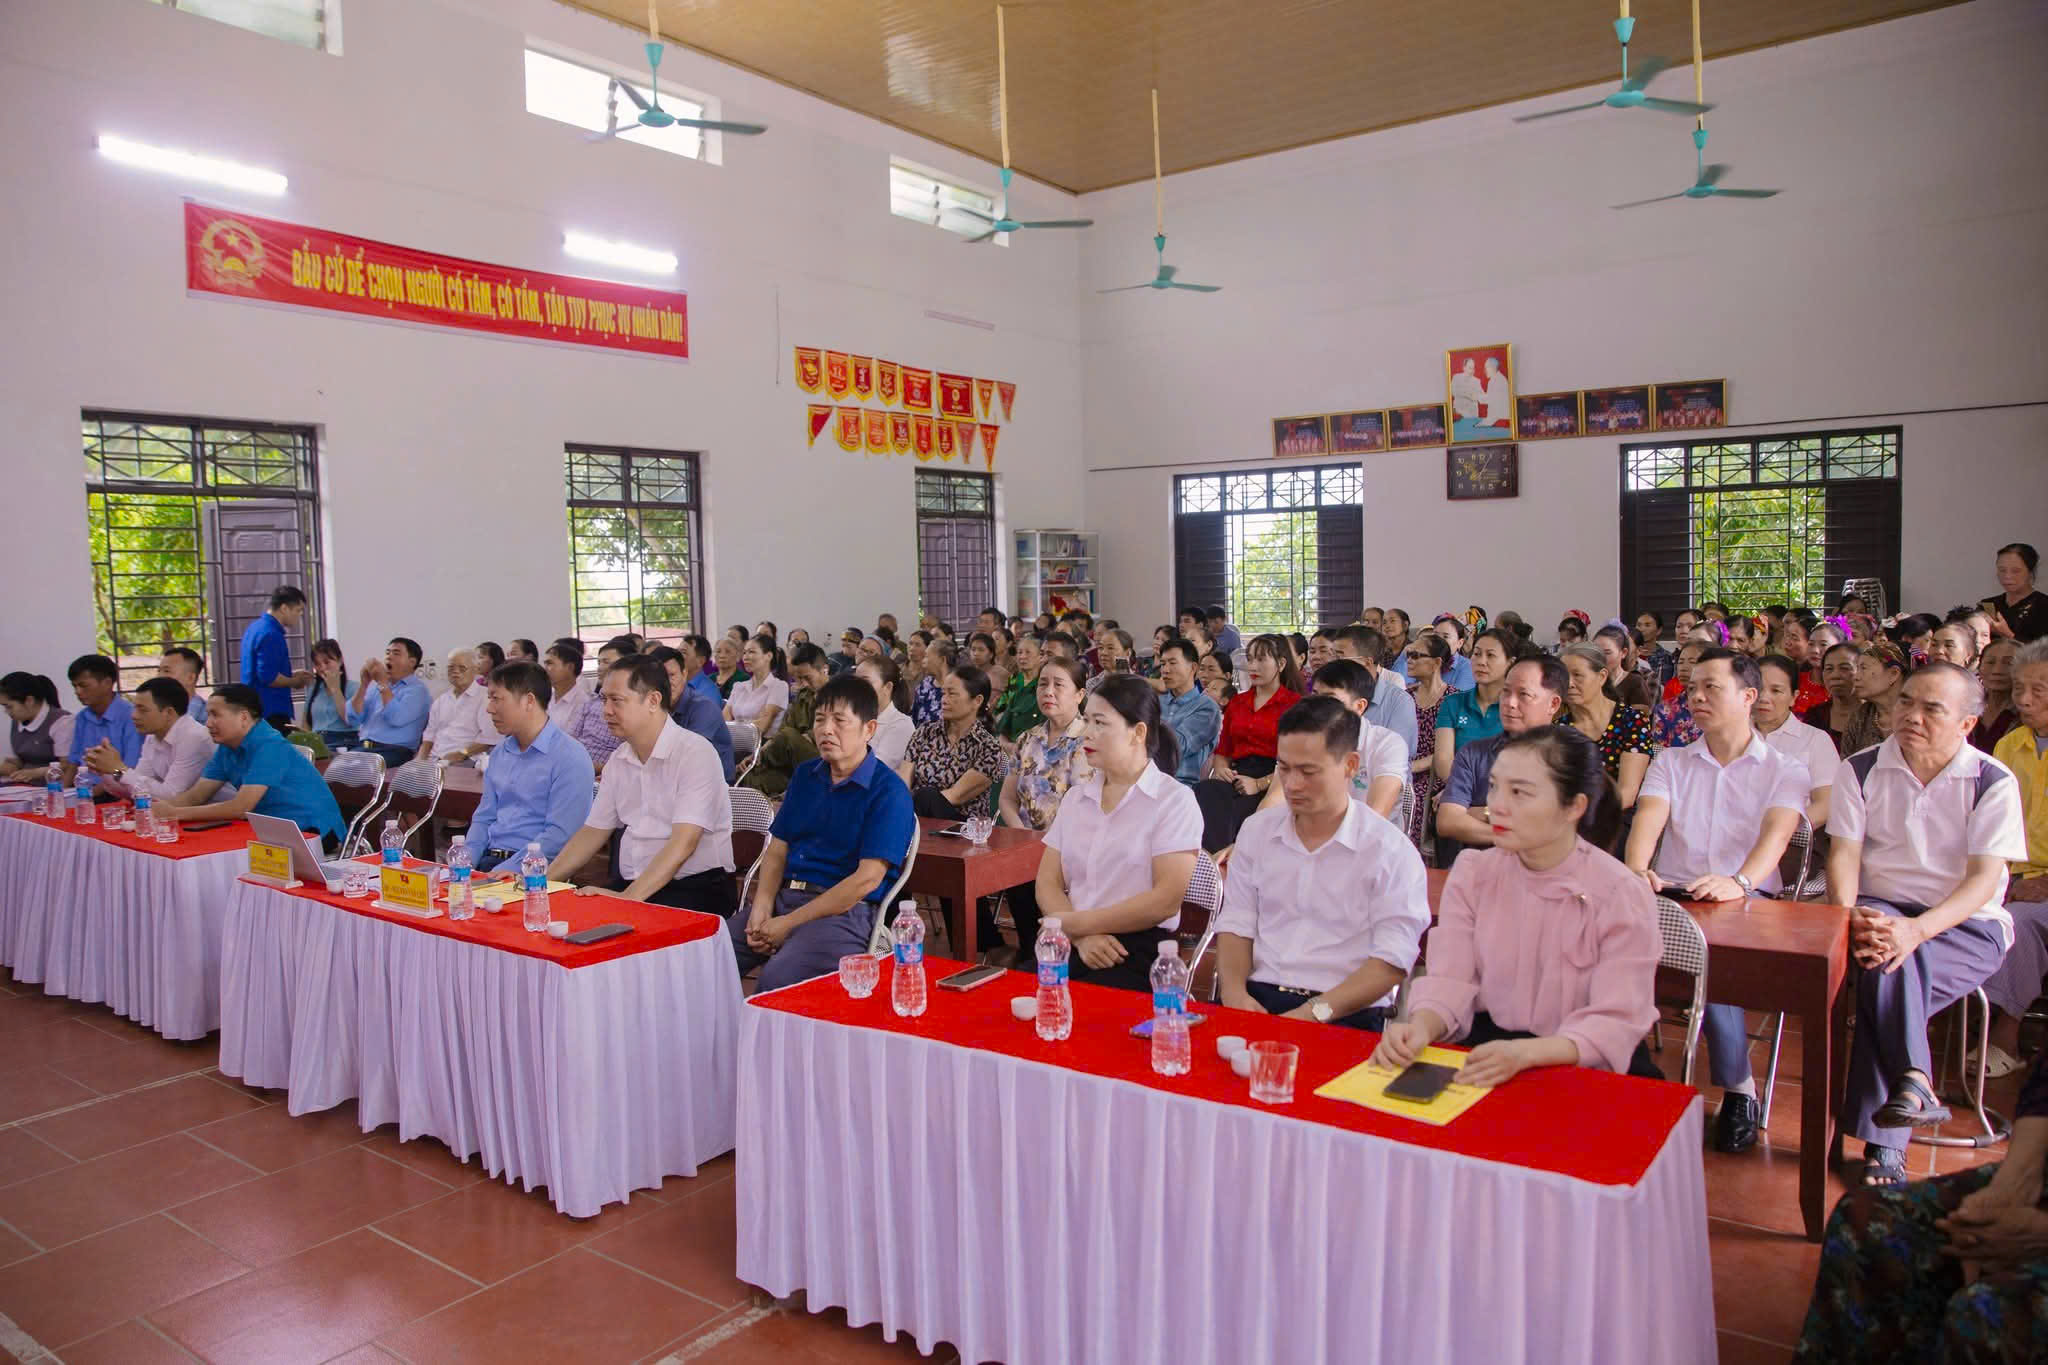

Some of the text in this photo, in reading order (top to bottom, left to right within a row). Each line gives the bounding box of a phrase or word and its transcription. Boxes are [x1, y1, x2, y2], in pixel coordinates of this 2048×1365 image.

[367, 263, 405, 309] CHỌN
[405, 264, 446, 309] NGƯỜI
[447, 270, 465, 312] CÓ
[497, 278, 514, 319] CÓ
[543, 286, 567, 333] TẬN
[588, 299, 616, 340] PHỤC
[617, 303, 631, 343] VỤ
[632, 301, 660, 340] NHÂN
